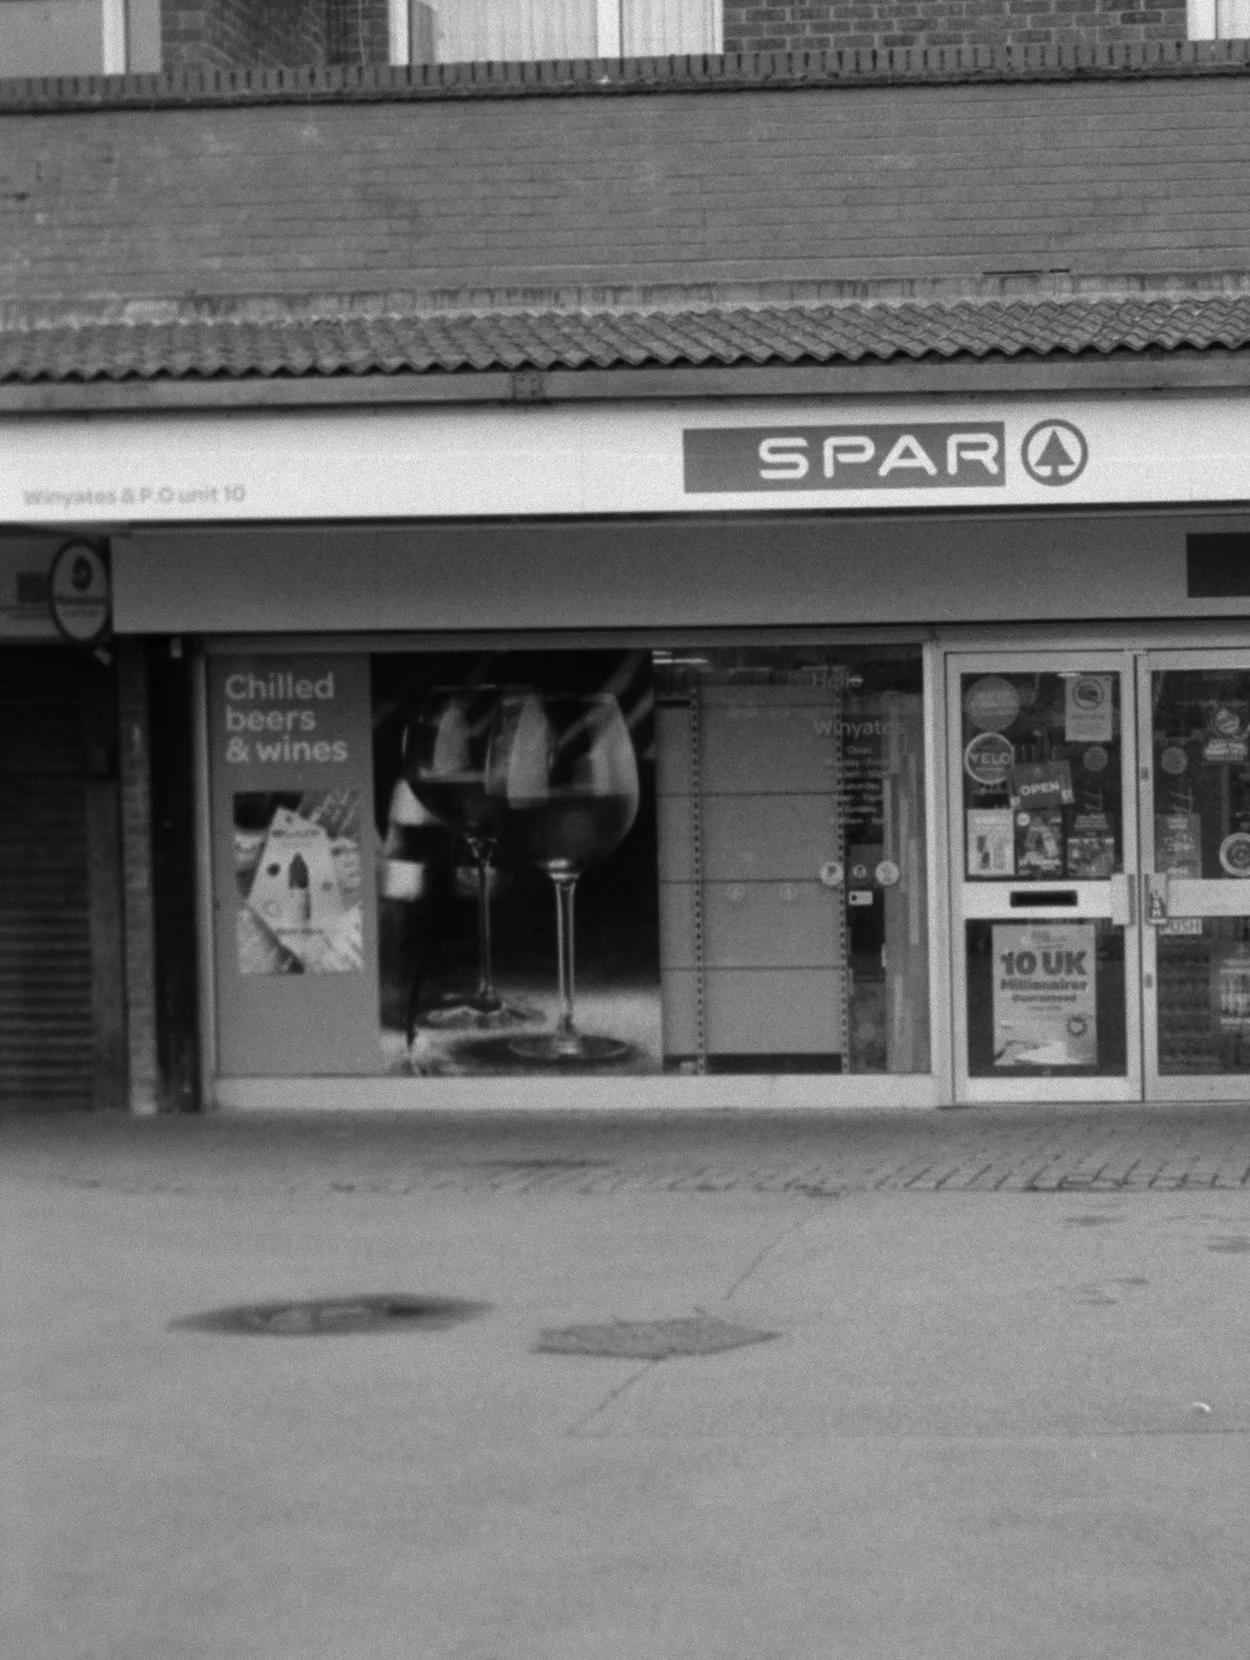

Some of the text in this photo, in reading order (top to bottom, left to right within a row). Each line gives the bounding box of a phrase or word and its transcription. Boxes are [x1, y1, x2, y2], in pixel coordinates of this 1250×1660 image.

[758, 432, 999, 480] SPAR
[224, 484, 247, 503] 10
[224, 672, 335, 700] Chilled
[225, 704, 317, 732] beers
[226, 734, 349, 763] & wines
[1020, 780, 1060, 796] OPEN
[1001, 950, 1088, 976] 10 UK
